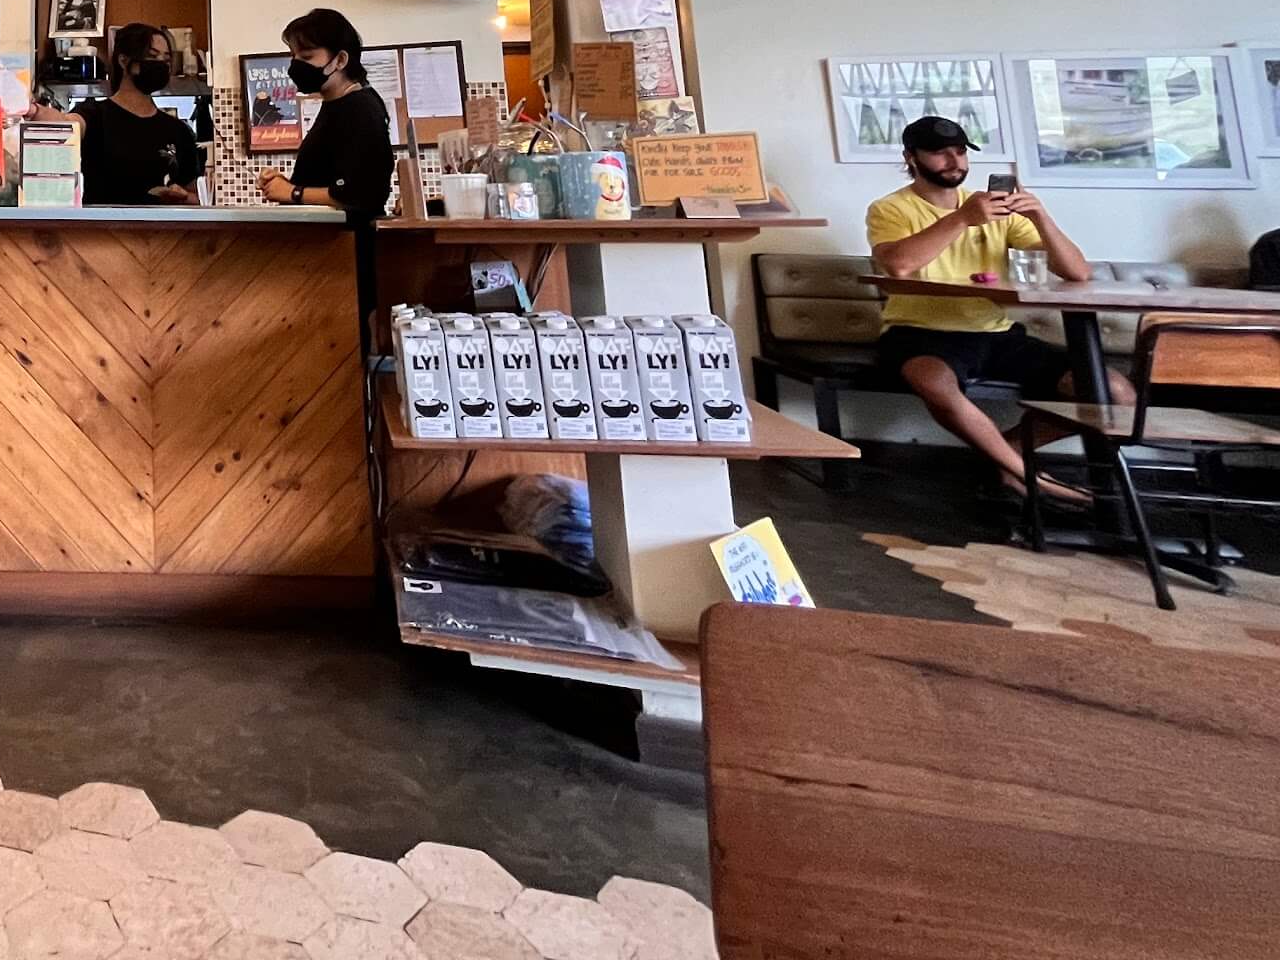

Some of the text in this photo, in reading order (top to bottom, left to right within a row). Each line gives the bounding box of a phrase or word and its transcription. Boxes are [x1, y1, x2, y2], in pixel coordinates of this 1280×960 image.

[413, 355, 439, 370] LY!
[456, 353, 484, 369] LY!
[502, 353, 531, 369] LY!
[549, 353, 579, 370] LY!
[598, 353, 628, 370] LY!
[646, 353, 678, 370] LY!
[699, 352, 730, 369] LY!
